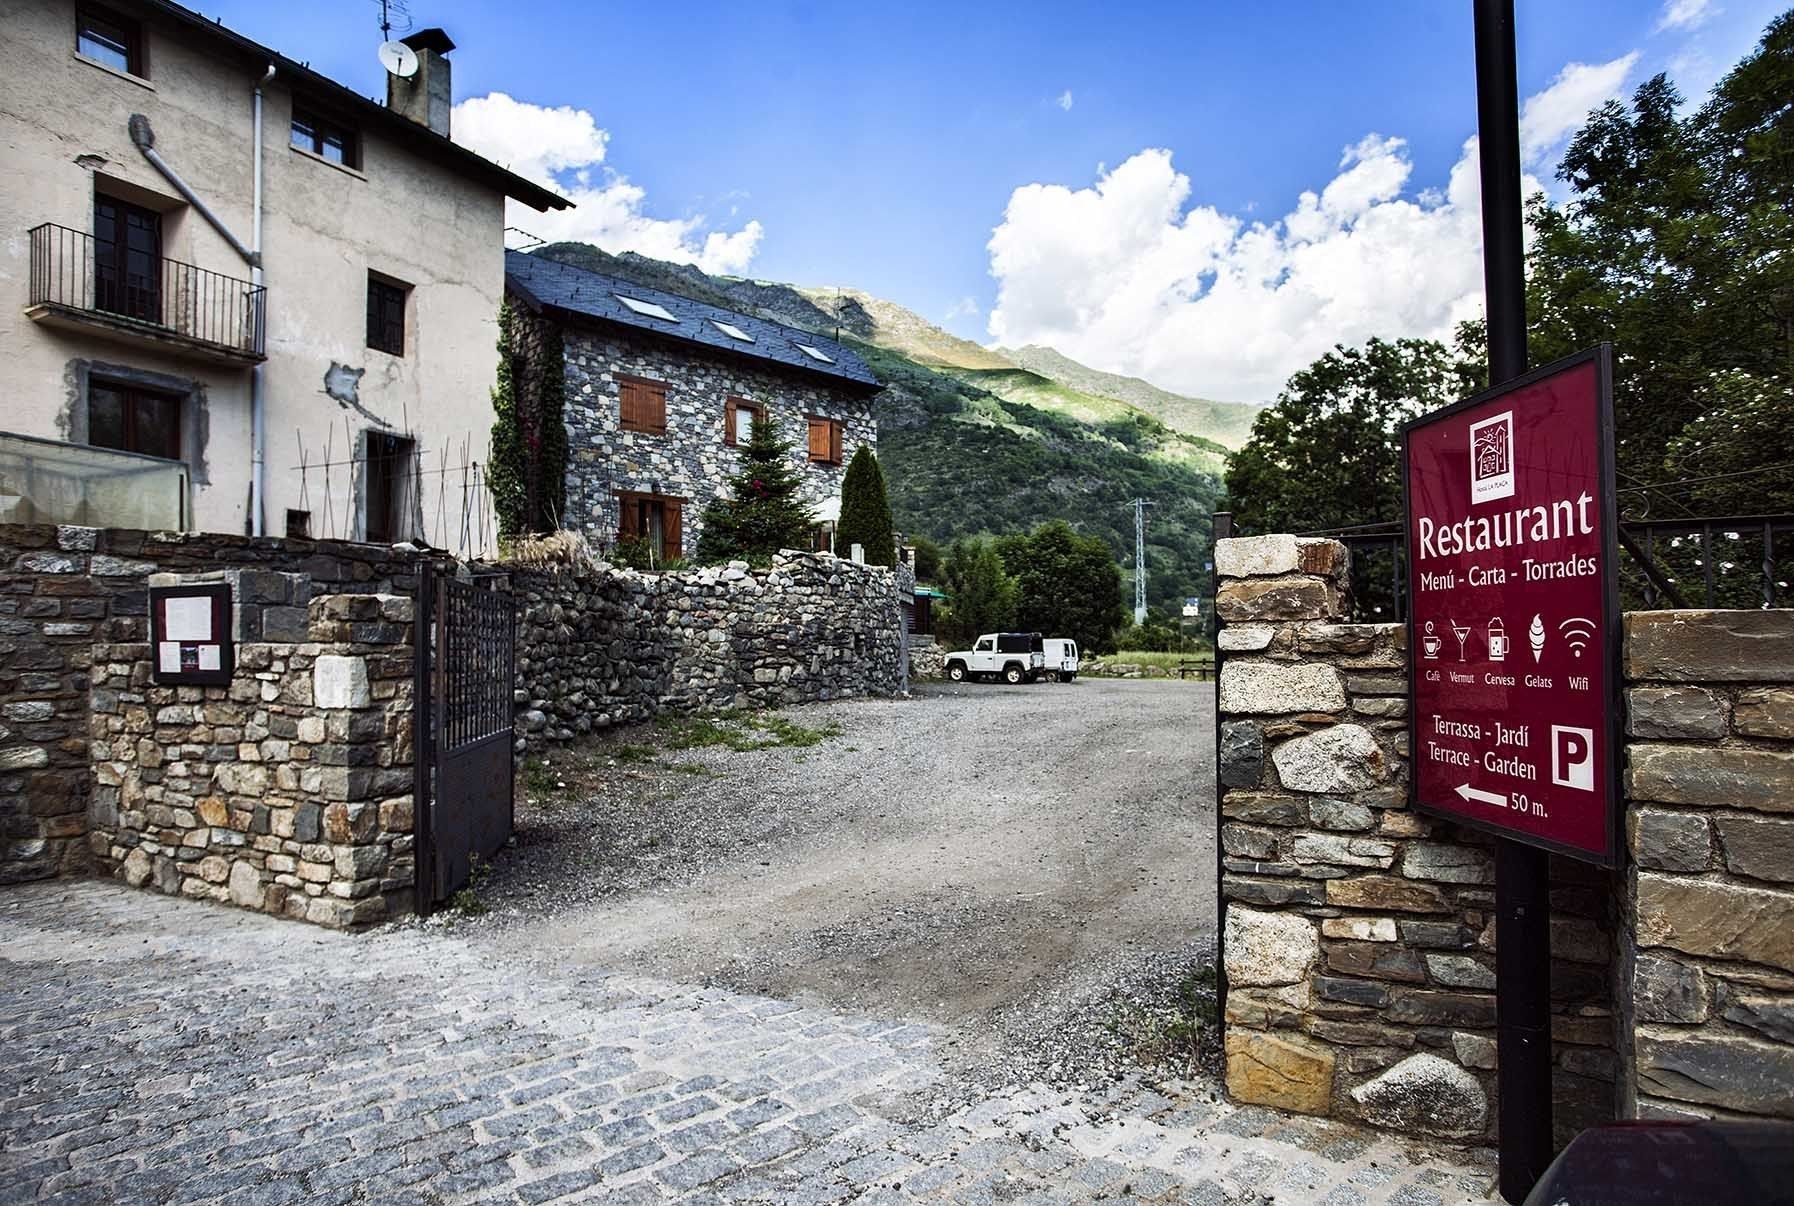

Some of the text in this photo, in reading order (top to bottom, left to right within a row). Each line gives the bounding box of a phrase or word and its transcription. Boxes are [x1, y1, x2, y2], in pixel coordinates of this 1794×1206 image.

[1418, 490, 1594, 560] Restaurant
[1420, 569, 1454, 592] Menú
[1468, 565, 1506, 587] Carta
[1522, 553, 1597, 581] Torrades
[1450, 671, 1475, 684] Vermut
[1484, 673, 1515, 687] Cervesa
[1525, 674, 1553, 689] Gelats
[1569, 676, 1589, 691] Wifi
[1433, 715, 1481, 740] Terrassa
[1495, 722, 1529, 747] Jardí
[1428, 741, 1470, 767] Terrace
[1484, 751, 1536, 781] Garden
[1557, 730, 1588, 782] P
[1511, 792, 1548, 818] 50 m.
